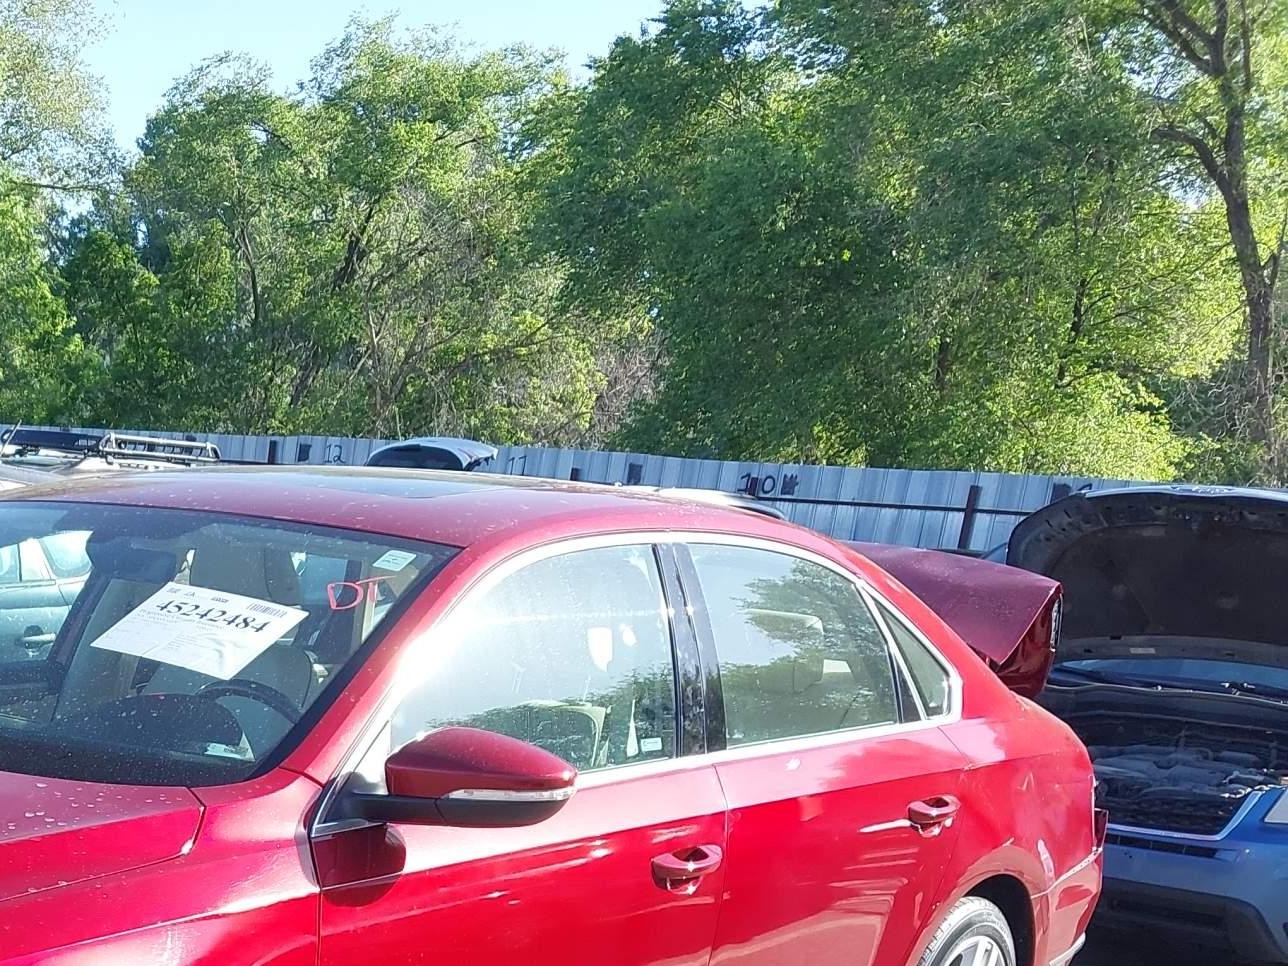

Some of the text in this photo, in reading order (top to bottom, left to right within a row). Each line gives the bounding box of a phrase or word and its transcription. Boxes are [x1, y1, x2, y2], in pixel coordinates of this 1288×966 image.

[324, 444, 346, 464] 12
[737, 472, 776, 495] 10
[155, 600, 271, 632] 45242484
